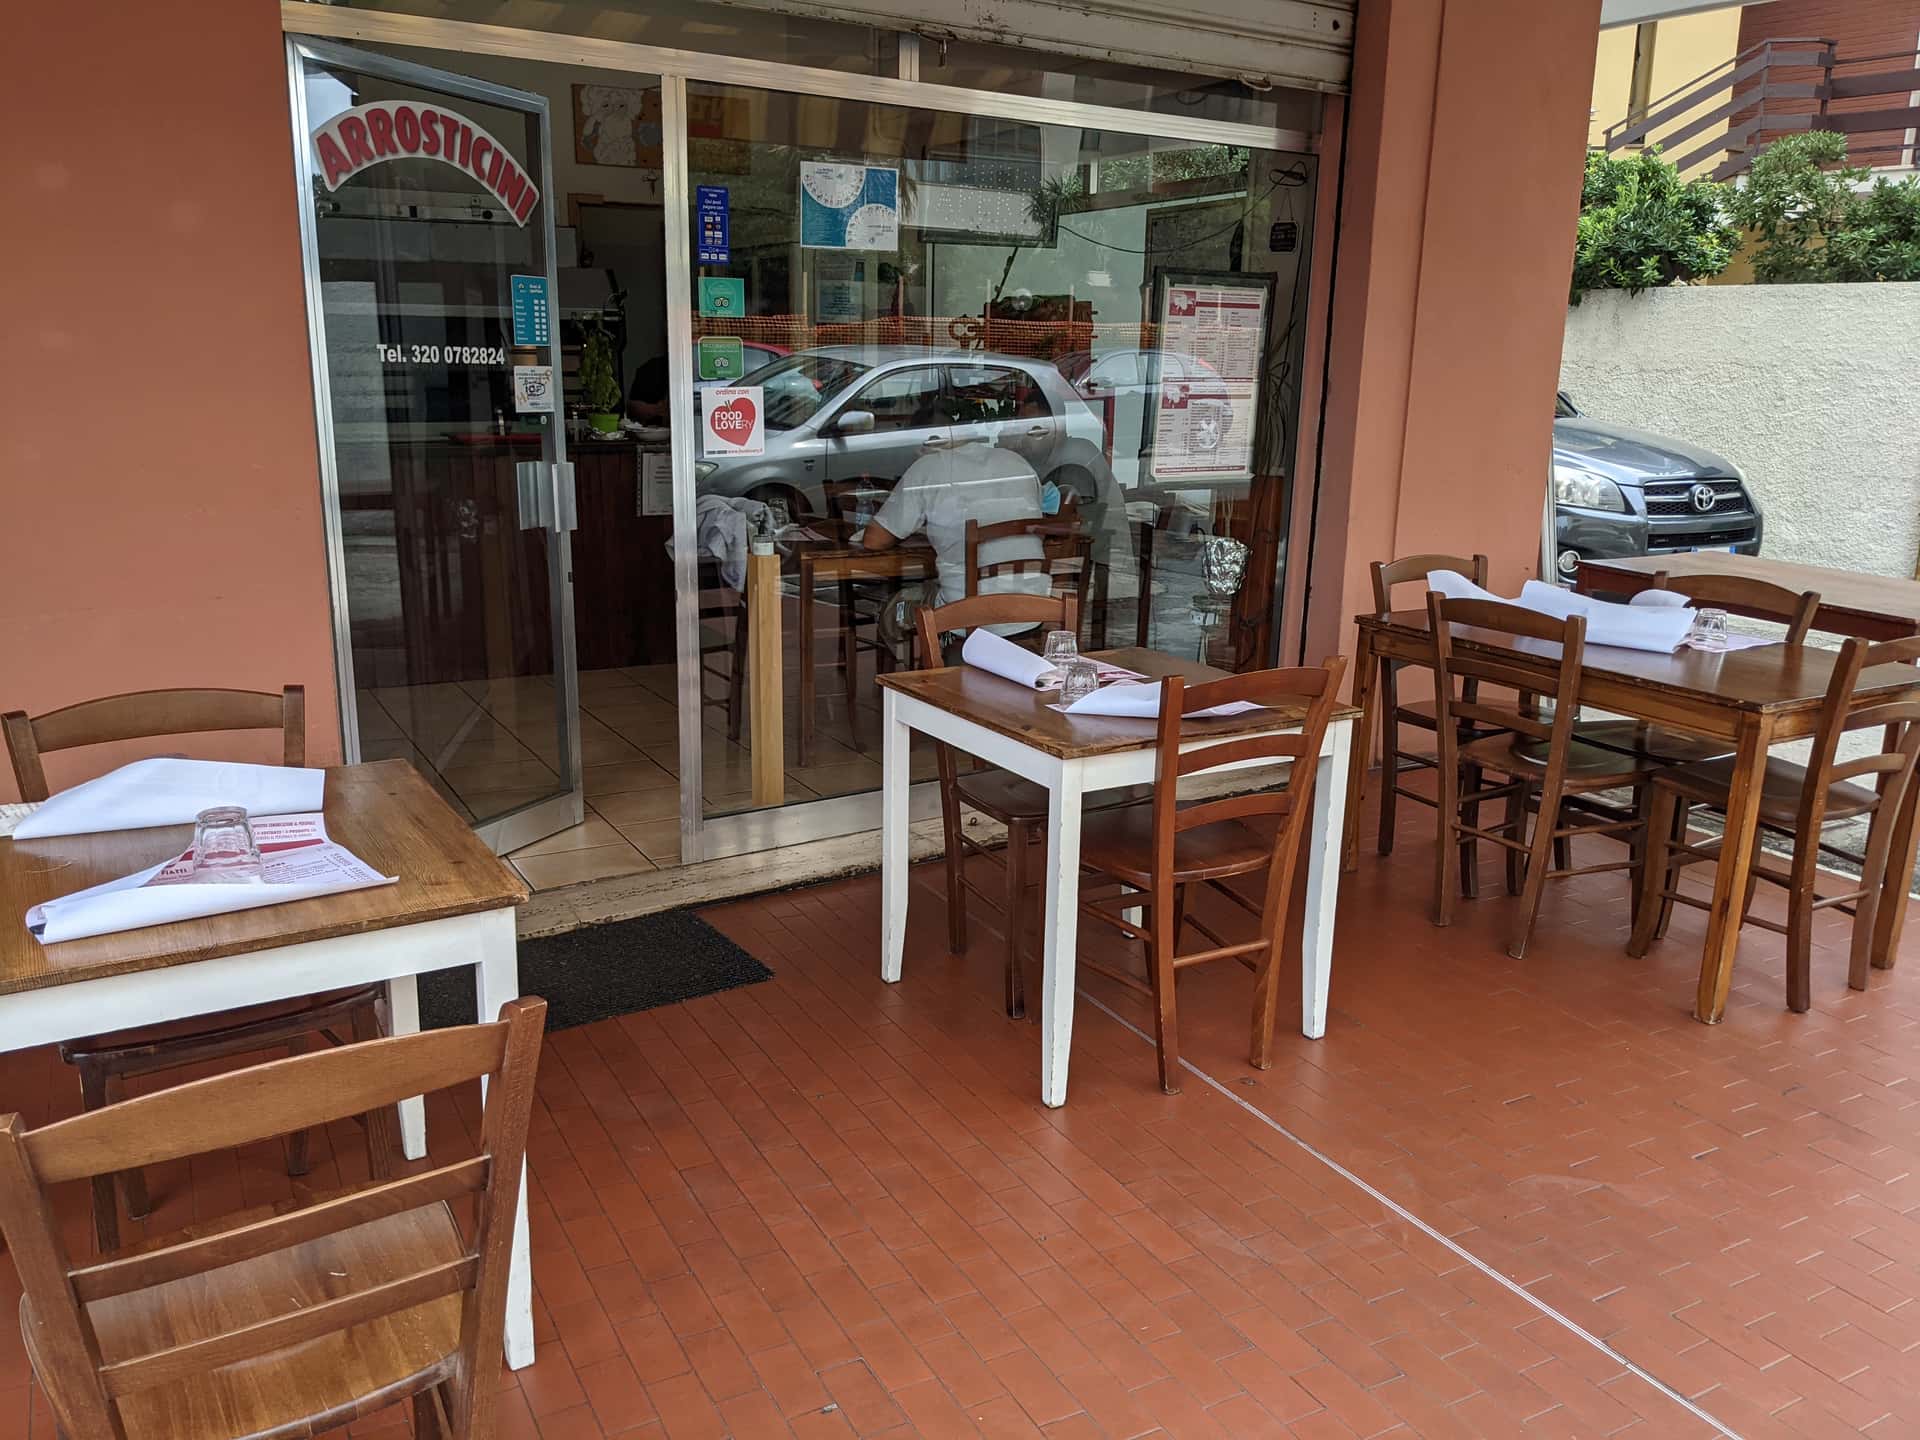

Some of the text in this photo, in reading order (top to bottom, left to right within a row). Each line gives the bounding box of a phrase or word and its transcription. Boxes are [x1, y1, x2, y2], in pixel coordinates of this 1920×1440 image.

[315, 106, 537, 221] ARROSTICINI
[376, 344, 505, 365] Tel. 320 0782824
[714, 411, 743, 420] FOOD
[715, 420, 754, 430] LOVERY
